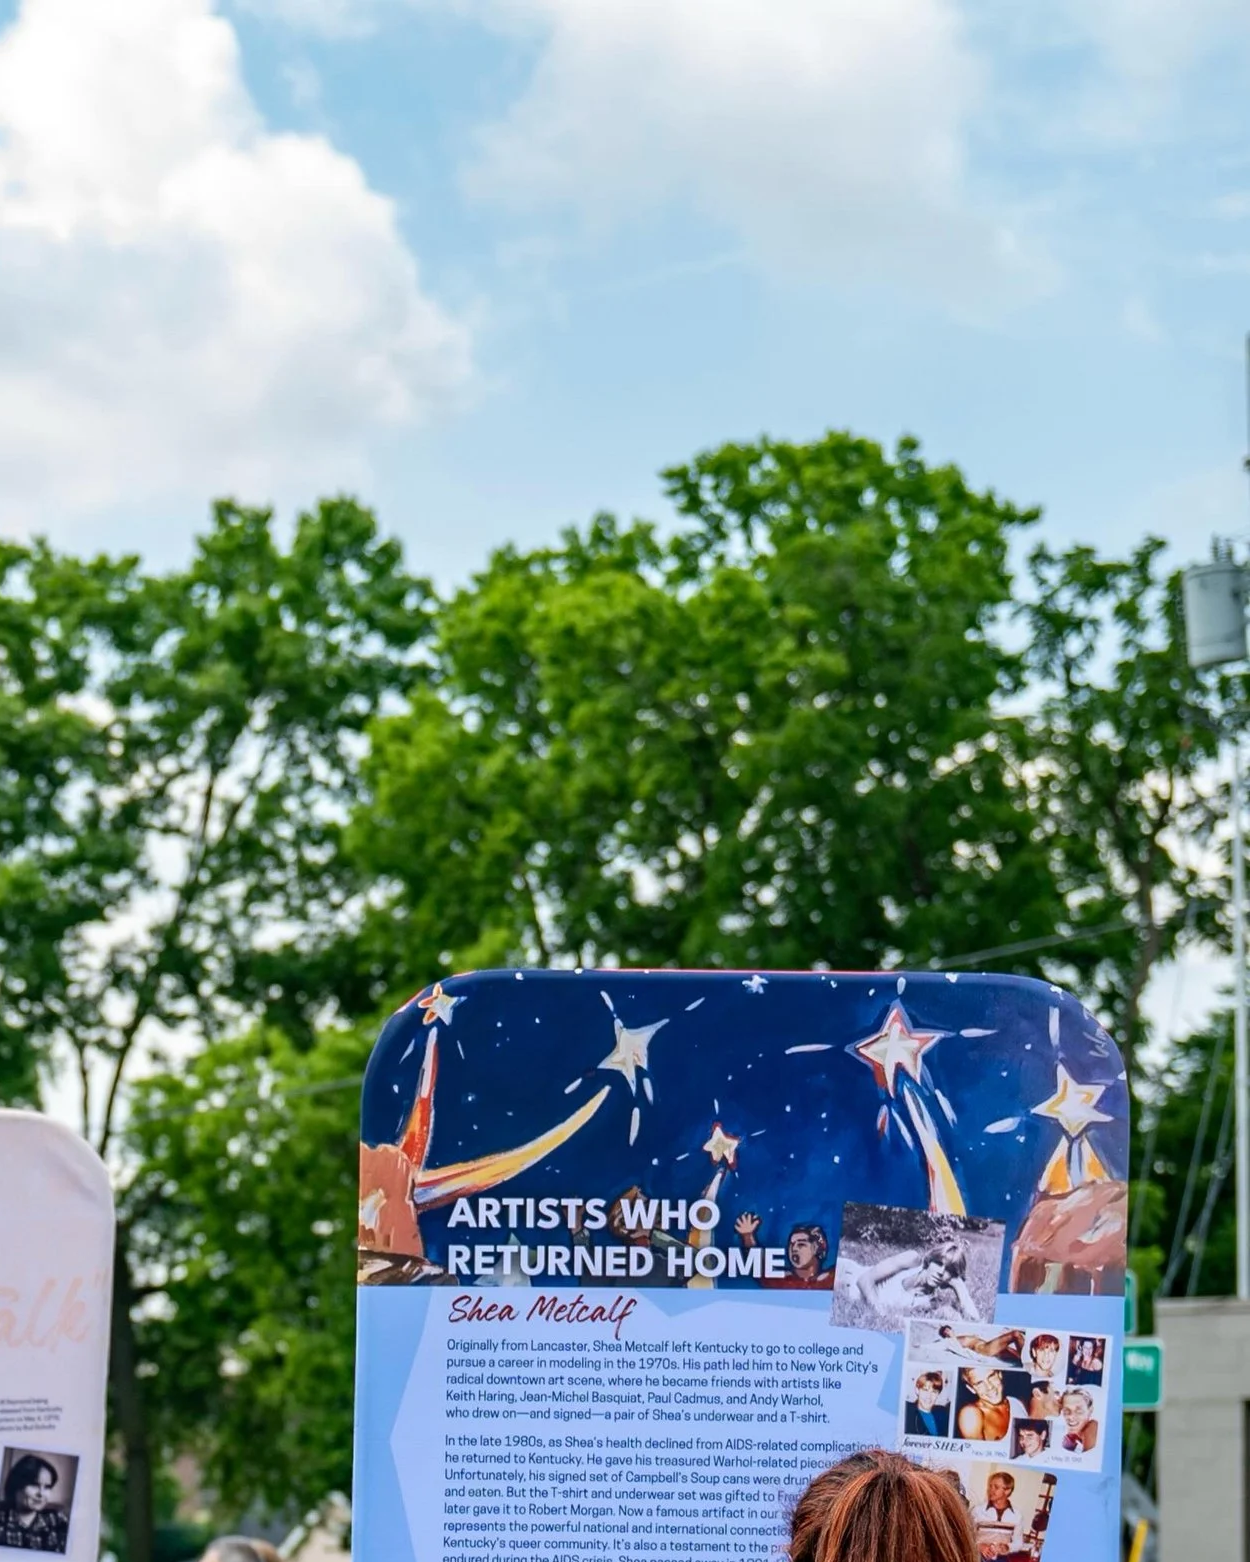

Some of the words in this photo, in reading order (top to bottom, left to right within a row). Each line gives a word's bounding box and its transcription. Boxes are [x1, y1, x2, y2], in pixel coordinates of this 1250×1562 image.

[447, 1197, 606, 1230] ARTISTS
[621, 1199, 720, 1230] WHO
[448, 1245, 653, 1278] RETURNED
[667, 1247, 785, 1279] HOME
[448, 1295, 519, 1324] Shea
[526, 1294, 638, 1340] Metcalf
[447, 1338, 499, 1354] Originally
[501, 1339, 528, 1351] from
[531, 1339, 590, 1353] Lancaster,
[593, 1338, 622, 1352] Shea
[625, 1339, 670, 1353] Metcalf
[672, 1340, 692, 1353] left
[695, 1340, 748, 1356] Kentucky
[751, 1343, 763, 1354] to
[766, 1345, 780, 1356] go
[783, 1344, 795, 1355] to
[798, 1342, 840, 1357] college
[842, 1343, 863, 1356] and
[447, 1358, 486, 1370] pursue
[489, 1358, 495, 1367] a
[498, 1358, 534, 1368] career
[537, 1357, 546, 1368] in
[549, 1356, 601, 1372] modeling
[604, 1358, 614, 1369] in
[617, 1357, 636, 1369] the
[639, 1357, 680, 1370] 1970s.
[683, 1358, 701, 1370] His
[703, 1358, 730, 1372] path
[732, 1358, 749, 1370] led
[752, 1358, 773, 1371] him
[775, 1361, 788, 1372] to
[791, 1360, 816, 1372] New
[818, 1359, 843, 1373] York
[446, 1372, 484, 1385] radical
[486, 1373, 545, 1385] downtown
[548, 1375, 565, 1386] art
[567, 1377, 605, 1387] scene,
[608, 1374, 642, 1386] where
[645, 1375, 660, 1387] he
[662, 1375, 708, 1387] became
[711, 1375, 751, 1388] friends
[754, 1376, 778, 1388] with
[781, 1377, 820, 1390] artists
[823, 1378, 841, 1390] like
[446, 1390, 475, 1401] Keith
[478, 1389, 517, 1404] Haring,
[520, 1390, 589, 1402] Jean-Michel
[592, 1390, 644, 1405] Basquiat,
[648, 1392, 671, 1403] Paul
[674, 1391, 723, 1405] Cadmus,
[726, 1392, 747, 1405] and
[749, 1393, 779, 1408] Andy
[781, 1394, 823, 1408] Warhol,
[446, 1406, 470, 1418] who
[472, 1406, 500, 1419] drew
[614, 1408, 635, 1422] pair
[638, 1409, 650, 1421] of
[694, 1409, 754, 1422] underwear
[757, 1410, 778, 1422] and
[780, 1413, 787, 1422] a
[790, 1411, 830, 1424] T-shirt.
[932, 1441, 964, 1452] SHEA
